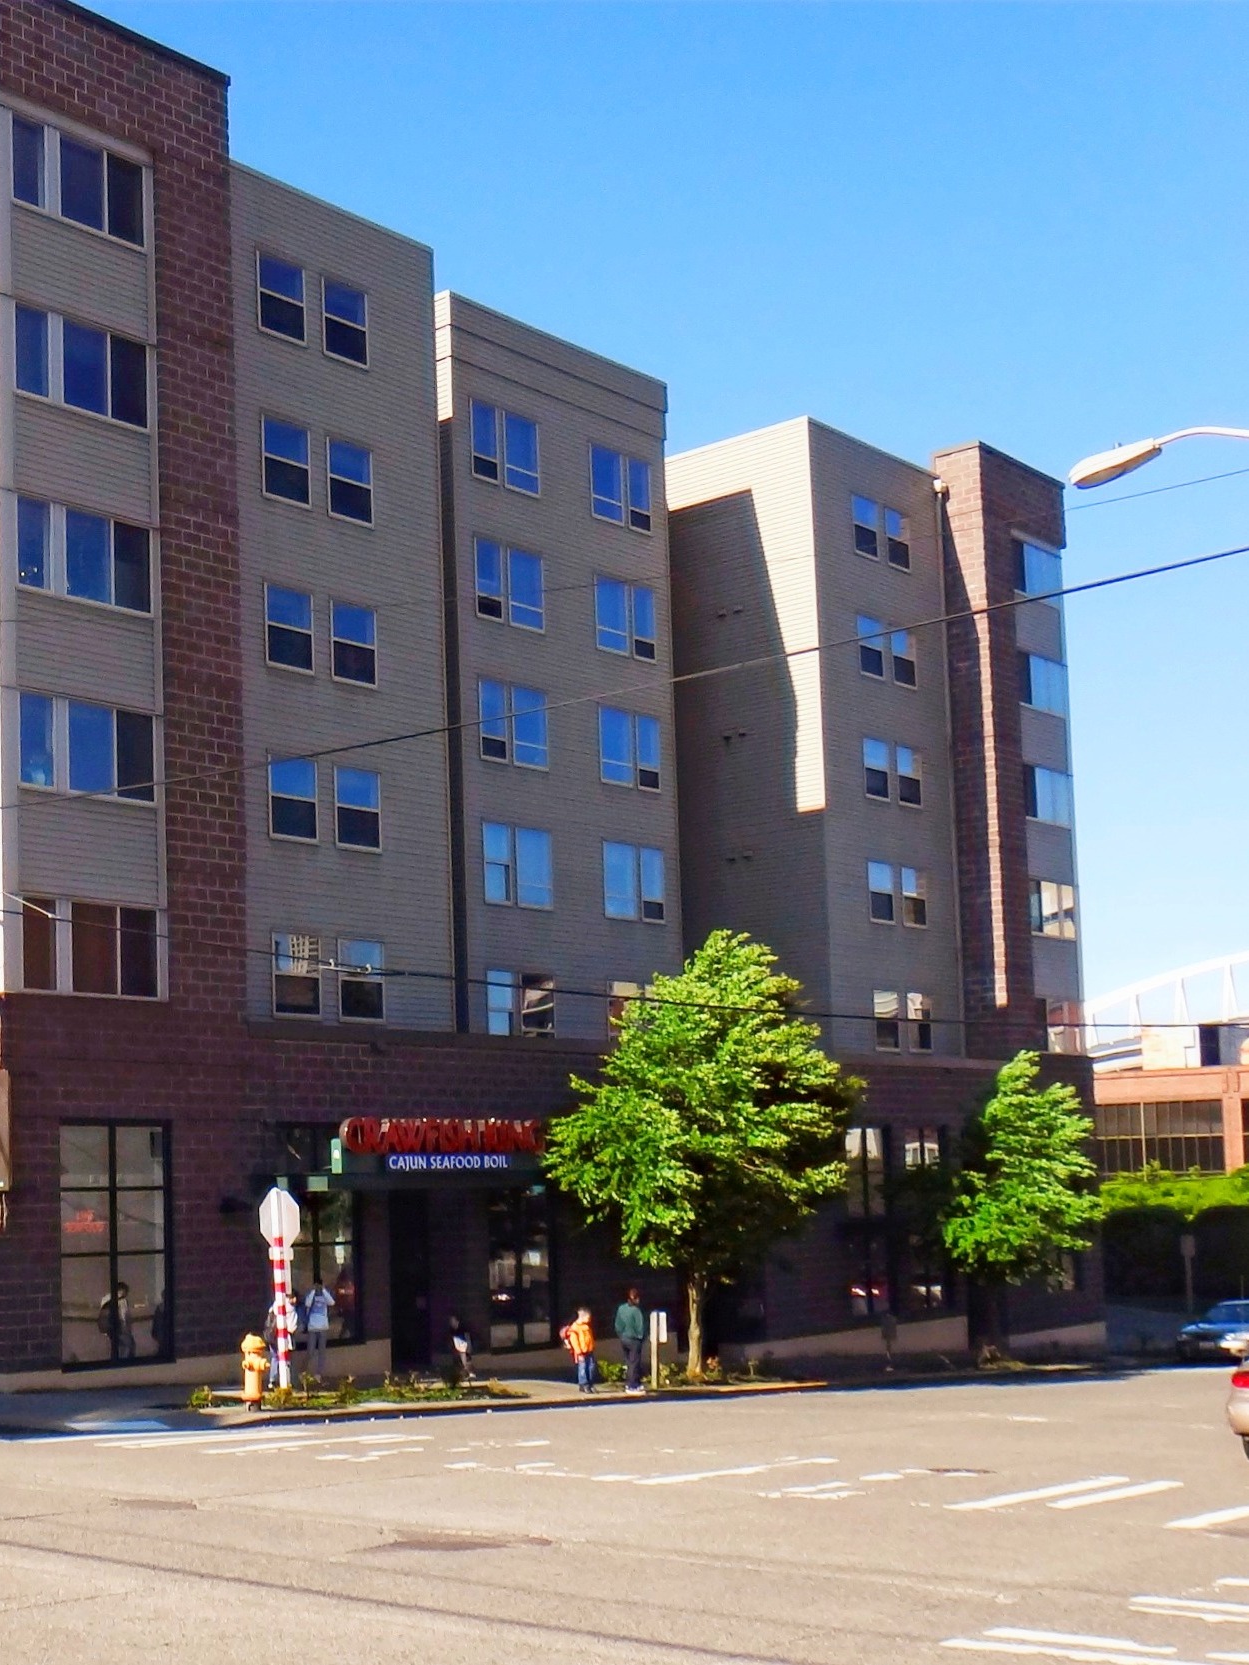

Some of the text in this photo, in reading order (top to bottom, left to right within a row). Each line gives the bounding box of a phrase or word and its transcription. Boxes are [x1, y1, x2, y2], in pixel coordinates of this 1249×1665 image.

[339, 1116, 546, 1155] CRAWFISH KING
[388, 1154, 508, 1171] CAJUN SEAFOOD BOIL
